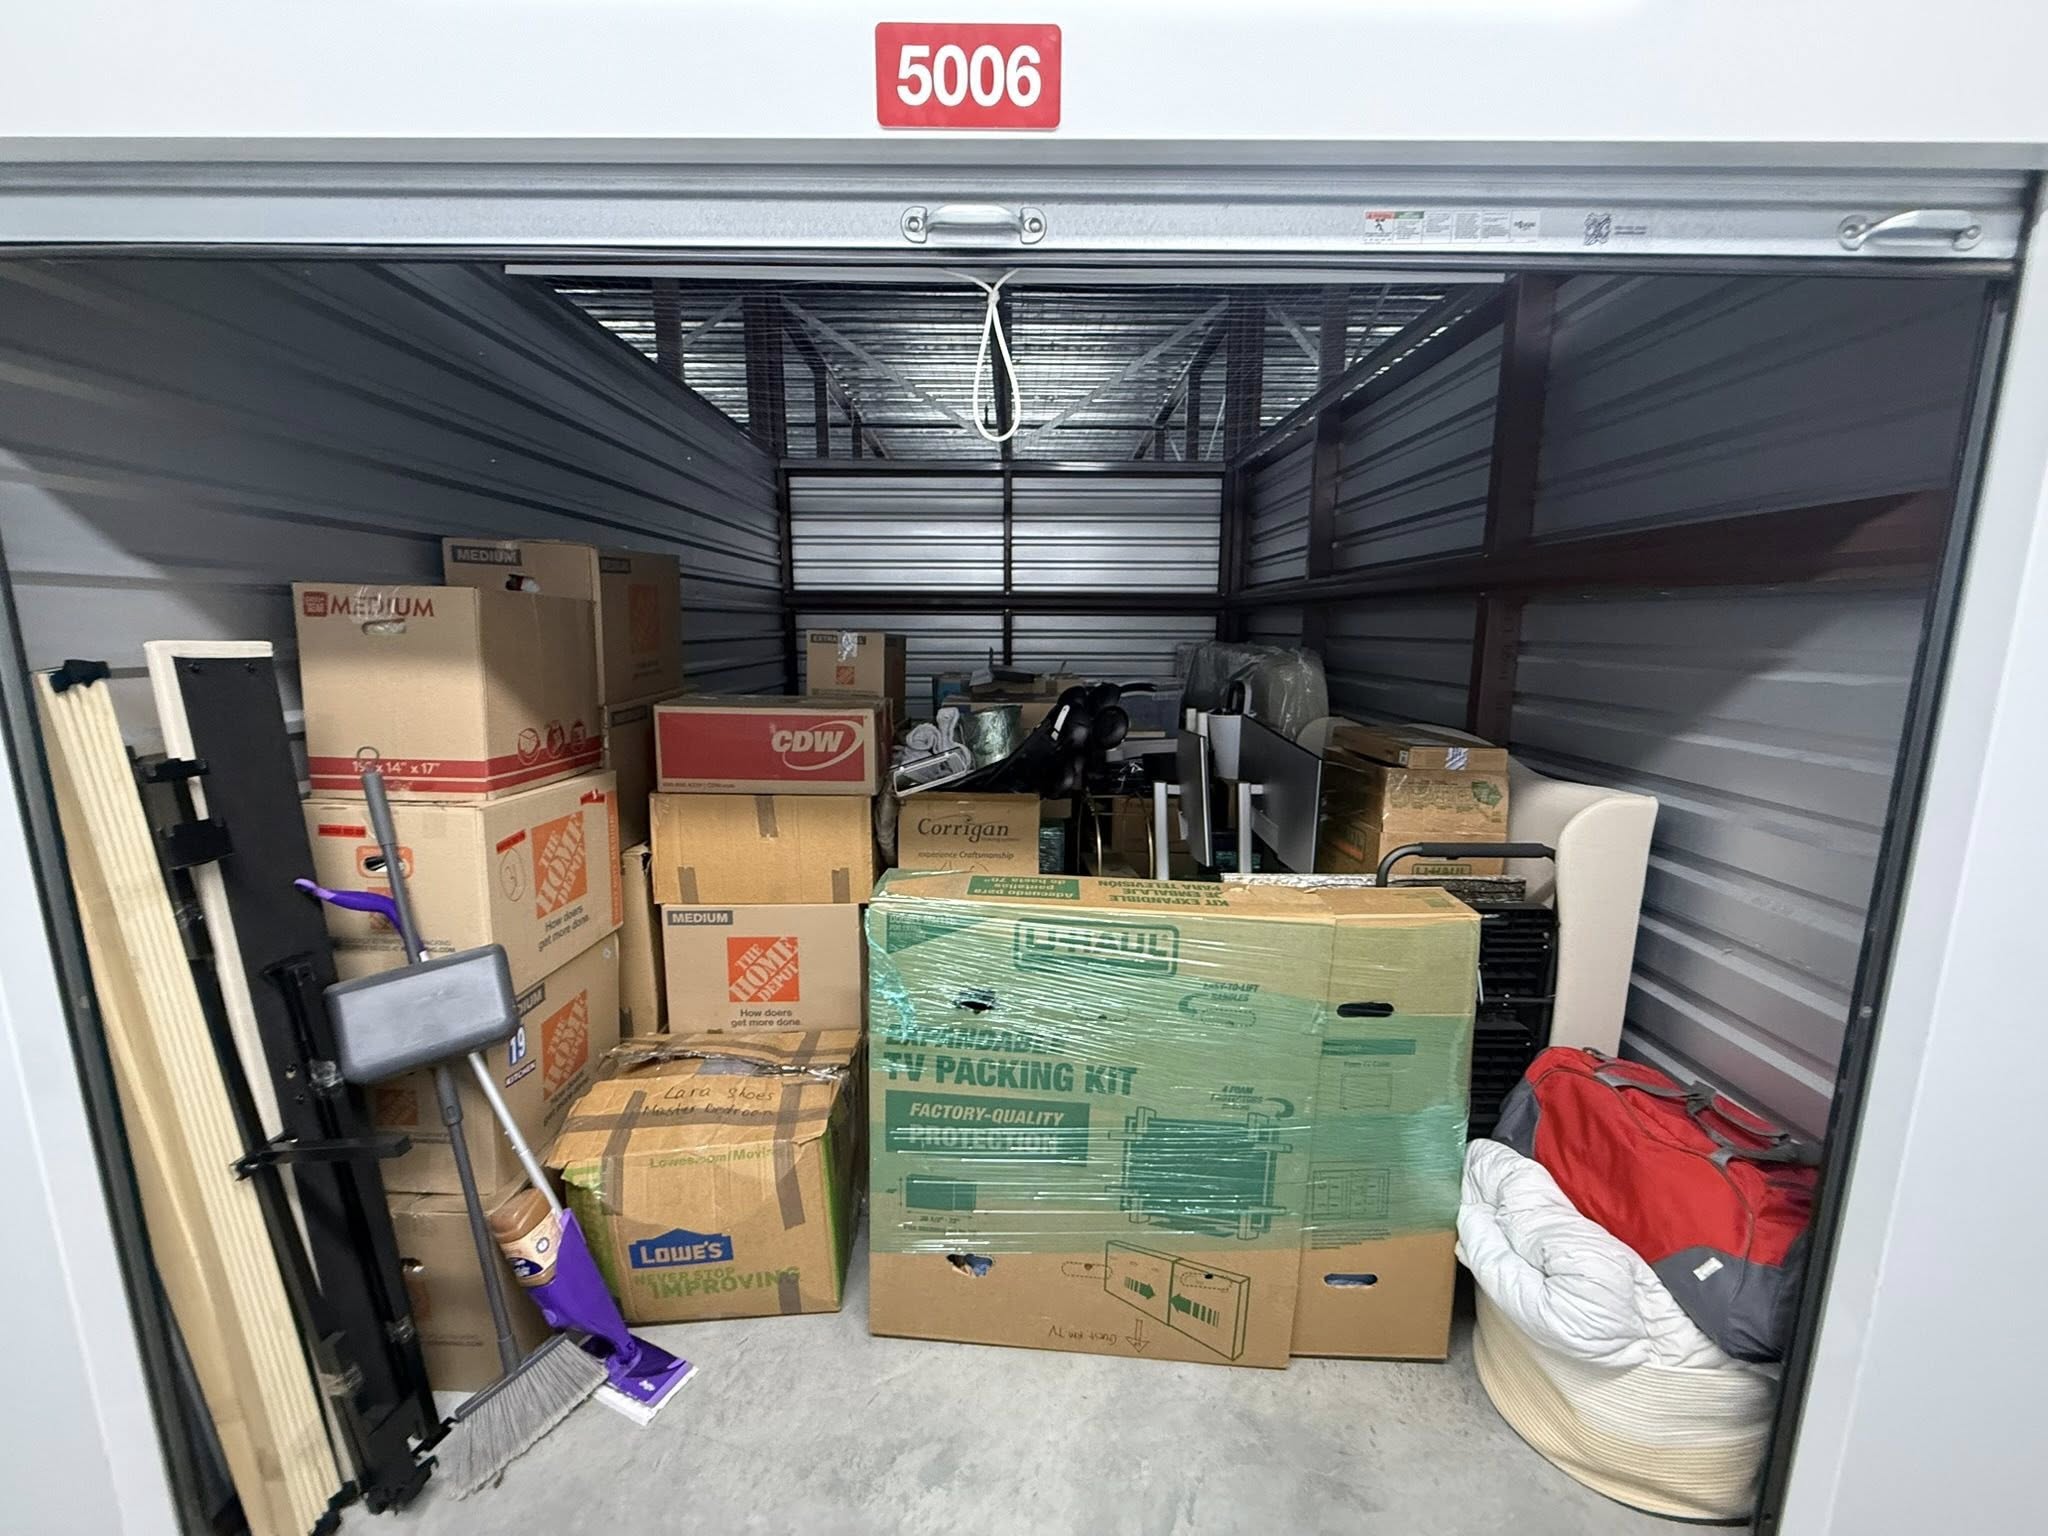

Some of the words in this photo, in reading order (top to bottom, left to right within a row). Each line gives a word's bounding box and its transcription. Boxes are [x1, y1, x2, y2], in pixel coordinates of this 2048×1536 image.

[897, 44, 1042, 107] 5006
[456, 548, 518, 564] MEDIUM
[330, 595, 435, 617] MEDIUM
[771, 730, 844, 753] CDW
[917, 817, 1009, 843] Corrigan
[539, 830, 562, 868] THE
[959, 850, 1015, 860] Craftsmanship
[537, 813, 584, 913] HOME
[557, 842, 586, 905] DEPOT
[974, 888, 1004, 897] para
[1008, 889, 1074, 899] Adecuado
[1108, 895, 1201, 907] EXPANDIBLE
[1122, 888, 1201, 898] EMBALAJE
[1204, 898, 1230, 907] KIT
[545, 917, 562, 932] How
[563, 905, 584, 920] doers
[672, 912, 729, 923] MEDIUM
[553, 925, 571, 942] more
[734, 943, 765, 970] THE
[729, 937, 799, 1002] HOME
[757, 960, 799, 1001] DEPOT
[731, 1019, 747, 1027] get
[740, 1009, 762, 1017] How
[764, 1009, 792, 1017] doers
[510, 1027, 526, 1065] 19
[544, 993, 588, 1088] HOME
[549, 1017, 568, 1053] THE
[562, 1021, 588, 1079] DEPOT
[883, 1052, 926, 1083] TV
[936, 1055, 1075, 1092] PACKING
[1085, 1064, 1138, 1096] KIT
[664, 1086, 711, 1100] Lara
[910, 1102, 1065, 1127] FACTORY-QUALITY
[908, 1123, 1058, 1153] PROTECTION
[640, 1241, 723, 1265] LOWE'S
[633, 1271, 689, 1286] NEVER
[694, 1266, 736, 1281] STOP
[652, 1266, 801, 1299] IMPROVING
[1048, 1325, 1066, 1338] TV
